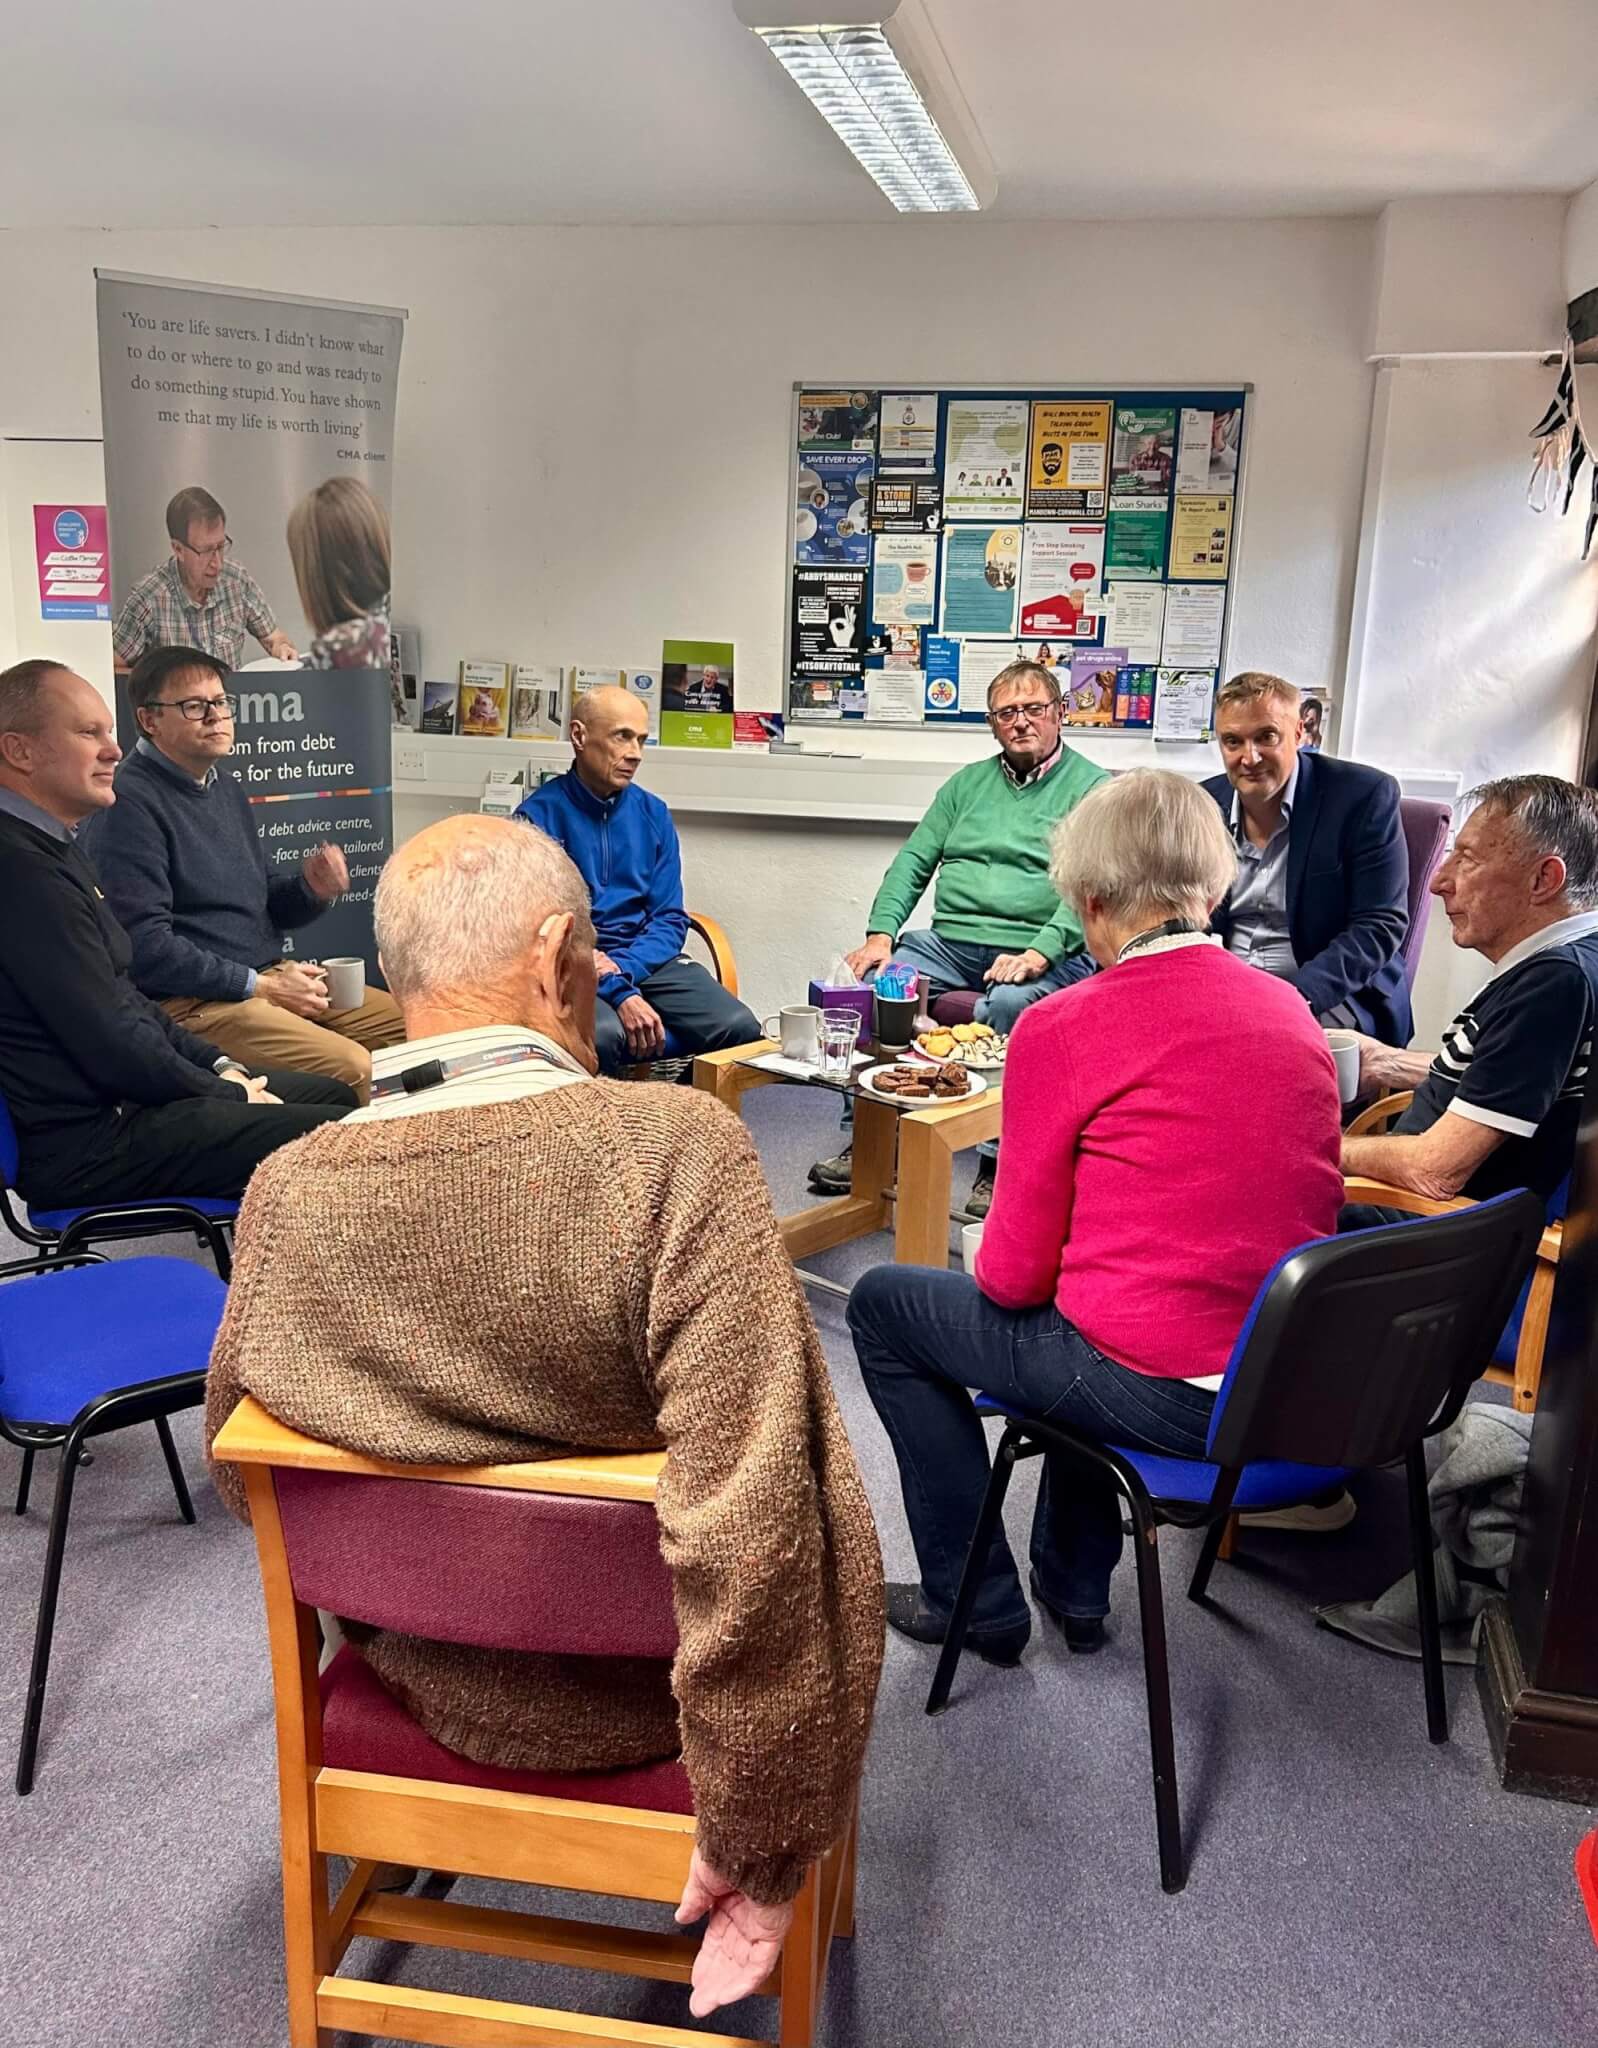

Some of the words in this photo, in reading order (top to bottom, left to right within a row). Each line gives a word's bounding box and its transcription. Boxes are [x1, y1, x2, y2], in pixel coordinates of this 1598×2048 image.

[161, 320, 184, 333] are
[188, 318, 210, 336] life
[214, 326, 261, 342] savers.
[265, 327, 271, 343] I
[275, 329, 315, 349] didn't
[319, 334, 354, 352] know
[357, 340, 385, 357] what
[127, 345, 143, 359] to
[147, 344, 166, 361] do
[170, 351, 187, 364] or
[191, 350, 233, 369] where
[237, 357, 252, 370] to
[256, 360, 273, 375] go
[277, 359, 302, 375] and
[305, 365, 331, 378] was
[335, 366, 369, 385] ready
[371, 371, 382, 383] to
[131, 374, 151, 390] do
[155, 380, 229, 401] something
[232, 384, 279, 403] stupid.
[280, 386, 306, 404] You
[310, 389, 341, 408] have
[344, 393, 382, 410] shown
[158, 410, 180, 423] me
[185, 408, 212, 426] that
[216, 415, 237, 431] my
[241, 412, 263, 430] life
[266, 415, 278, 430] is
[281, 418, 320, 434] worth
[336, 448, 362, 461] CMA
[363, 450, 387, 462] client
[806, 455, 824, 464] SAVE
[825, 455, 847, 464] EVERY
[846, 456, 867, 464] DROP
[876, 491, 883, 500] A
[883, 491, 911, 500] STORM
[1113, 500, 1134, 510] Loan
[1135, 500, 1163, 509] Sharks
[1031, 549, 1055, 558] Support
[1046, 542, 1060, 550] Stop
[1060, 542, 1086, 550] Smoking
[1074, 655, 1087, 663] pet
[1086, 655, 1104, 664] drugs
[1104, 655, 1123, 663] online
[231, 690, 305, 724] ma
[257, 736, 296, 754] from
[300, 732, 336, 751] debt
[247, 764, 272, 782] for
[277, 762, 303, 780] the
[306, 759, 355, 777] future
[269, 821, 295, 836] debt
[297, 818, 332, 834] advice
[335, 817, 373, 831] centre,
[343, 837, 385, 855] tailored
[349, 864, 383, 878] clients
